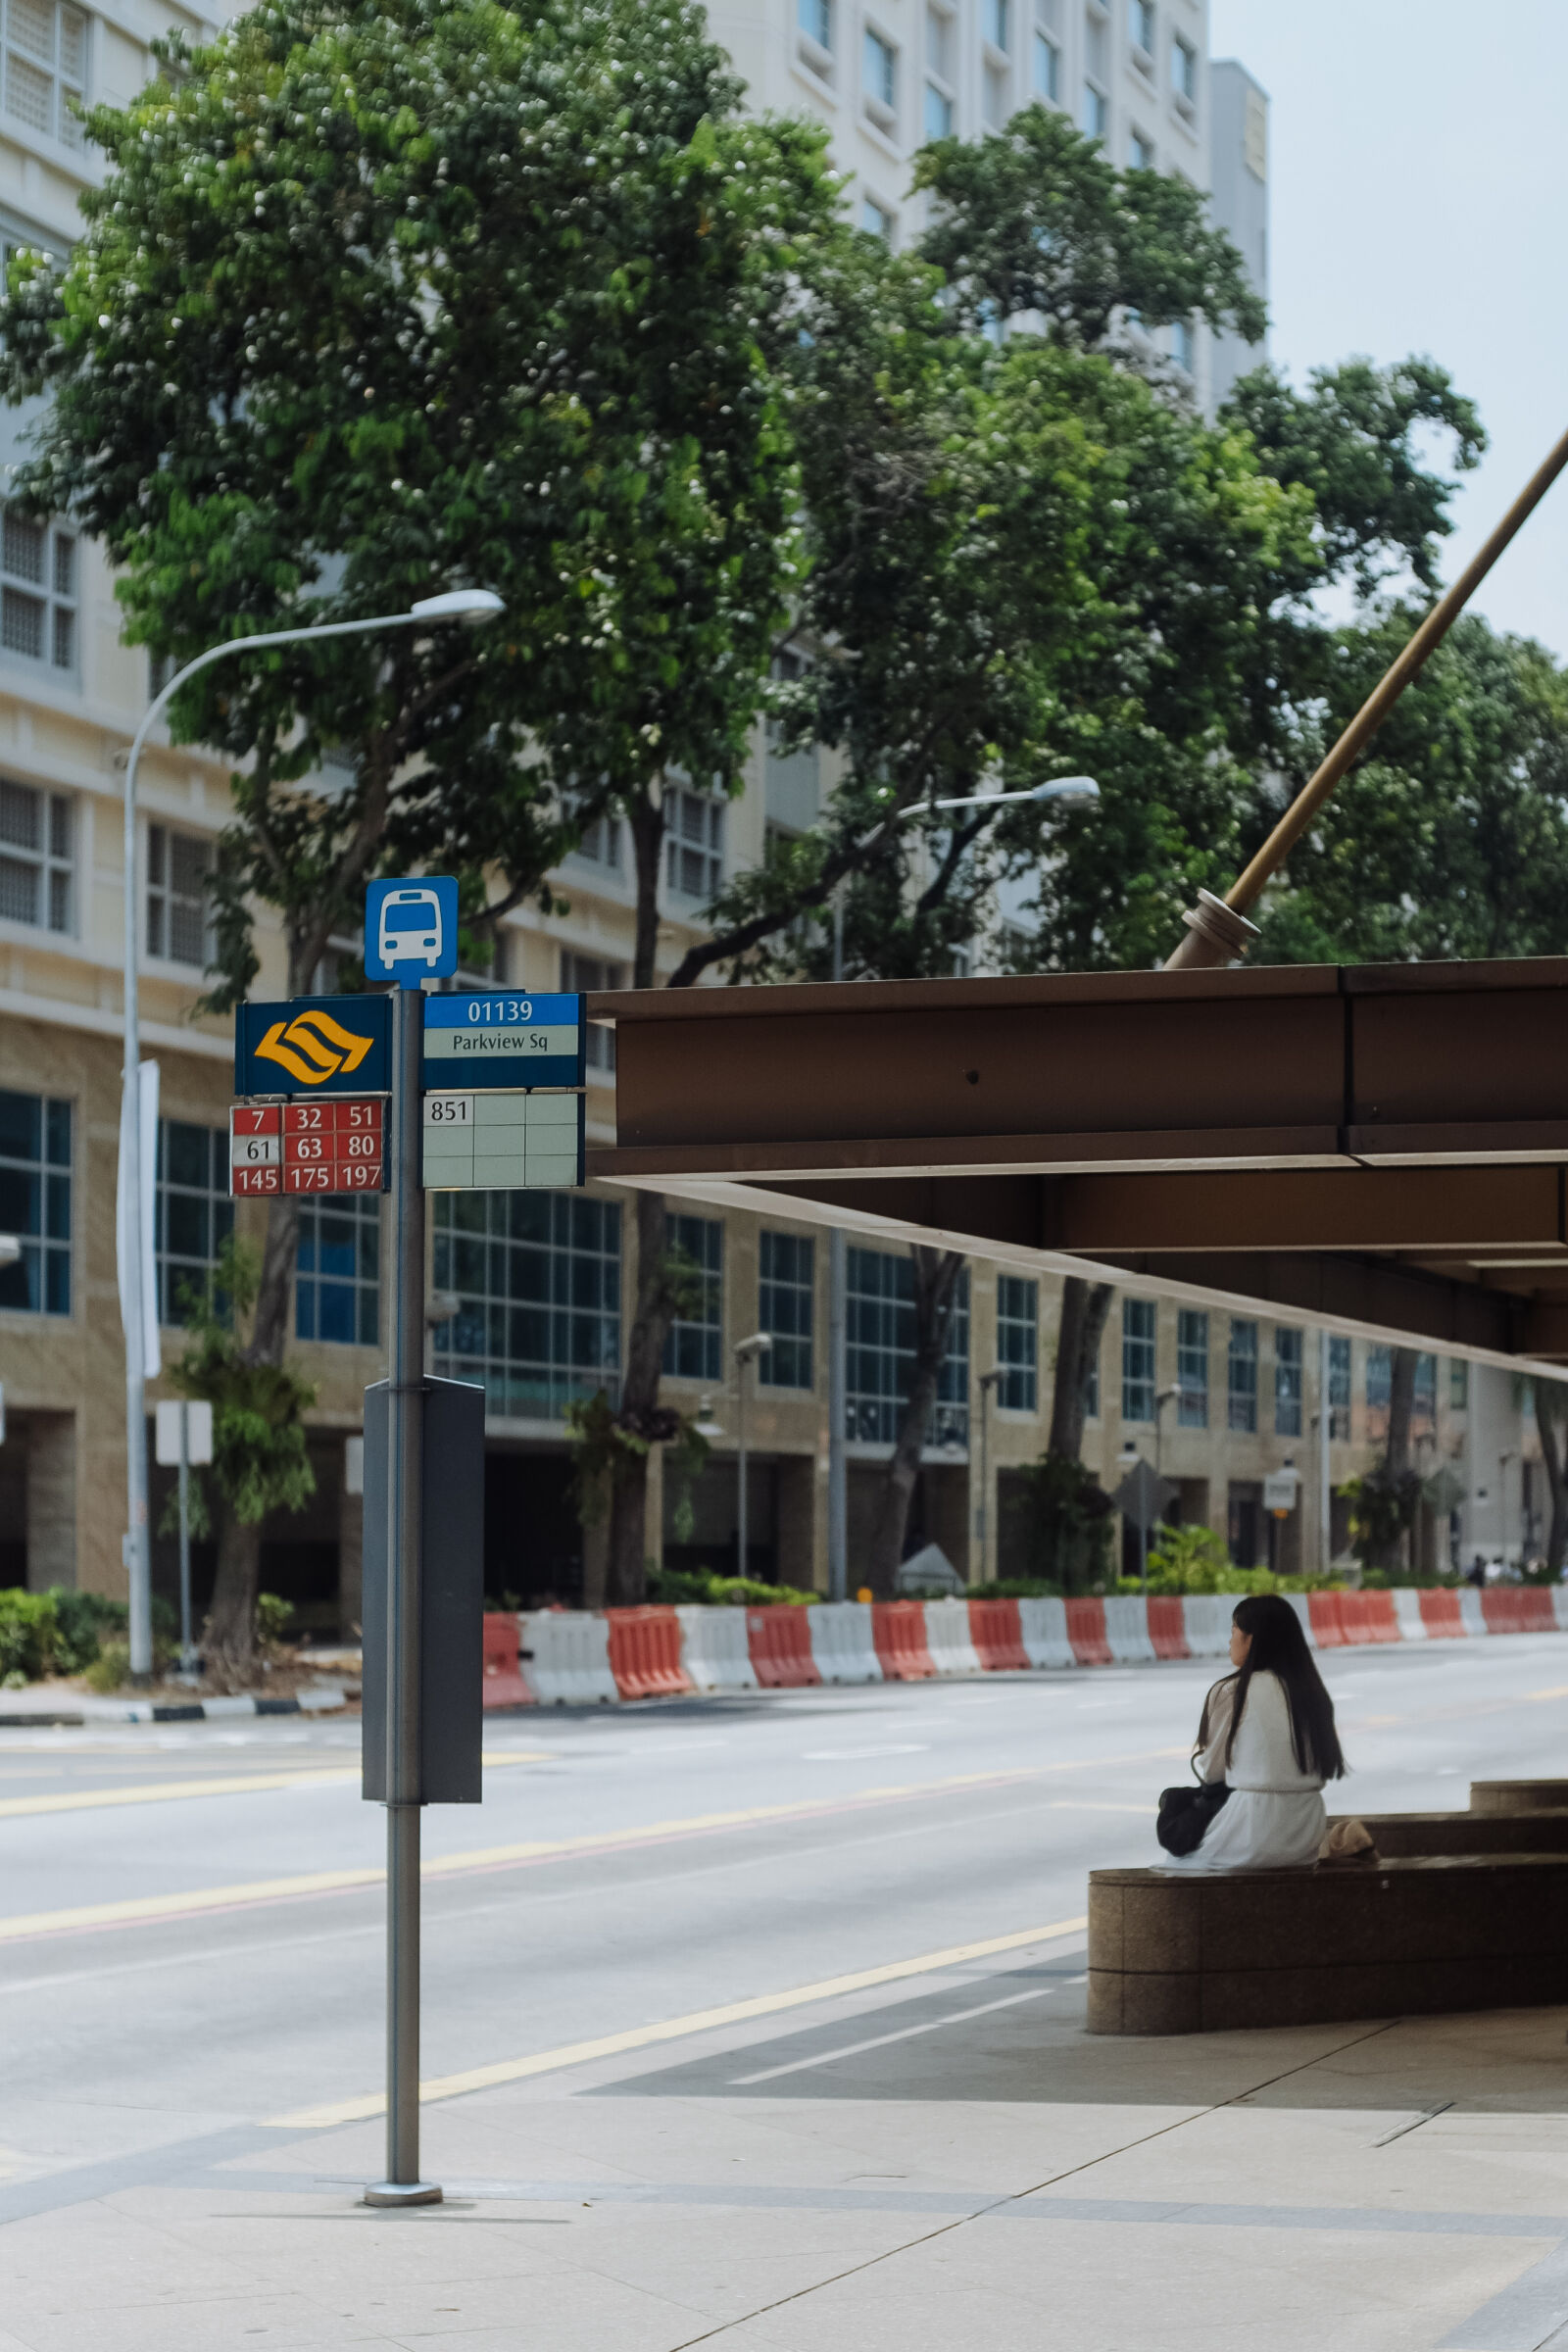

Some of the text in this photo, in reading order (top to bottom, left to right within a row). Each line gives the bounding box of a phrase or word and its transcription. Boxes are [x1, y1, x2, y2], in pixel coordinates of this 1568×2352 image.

[467, 1000, 533, 1022] 01139
[453, 1032, 549, 1052] Parkview Sq
[251, 1104, 373, 1131] 7 32 51
[430, 1101, 466, 1121] 851
[247, 1135, 374, 1159] 61 63 80
[238, 1165, 381, 1191] 145 175 197
